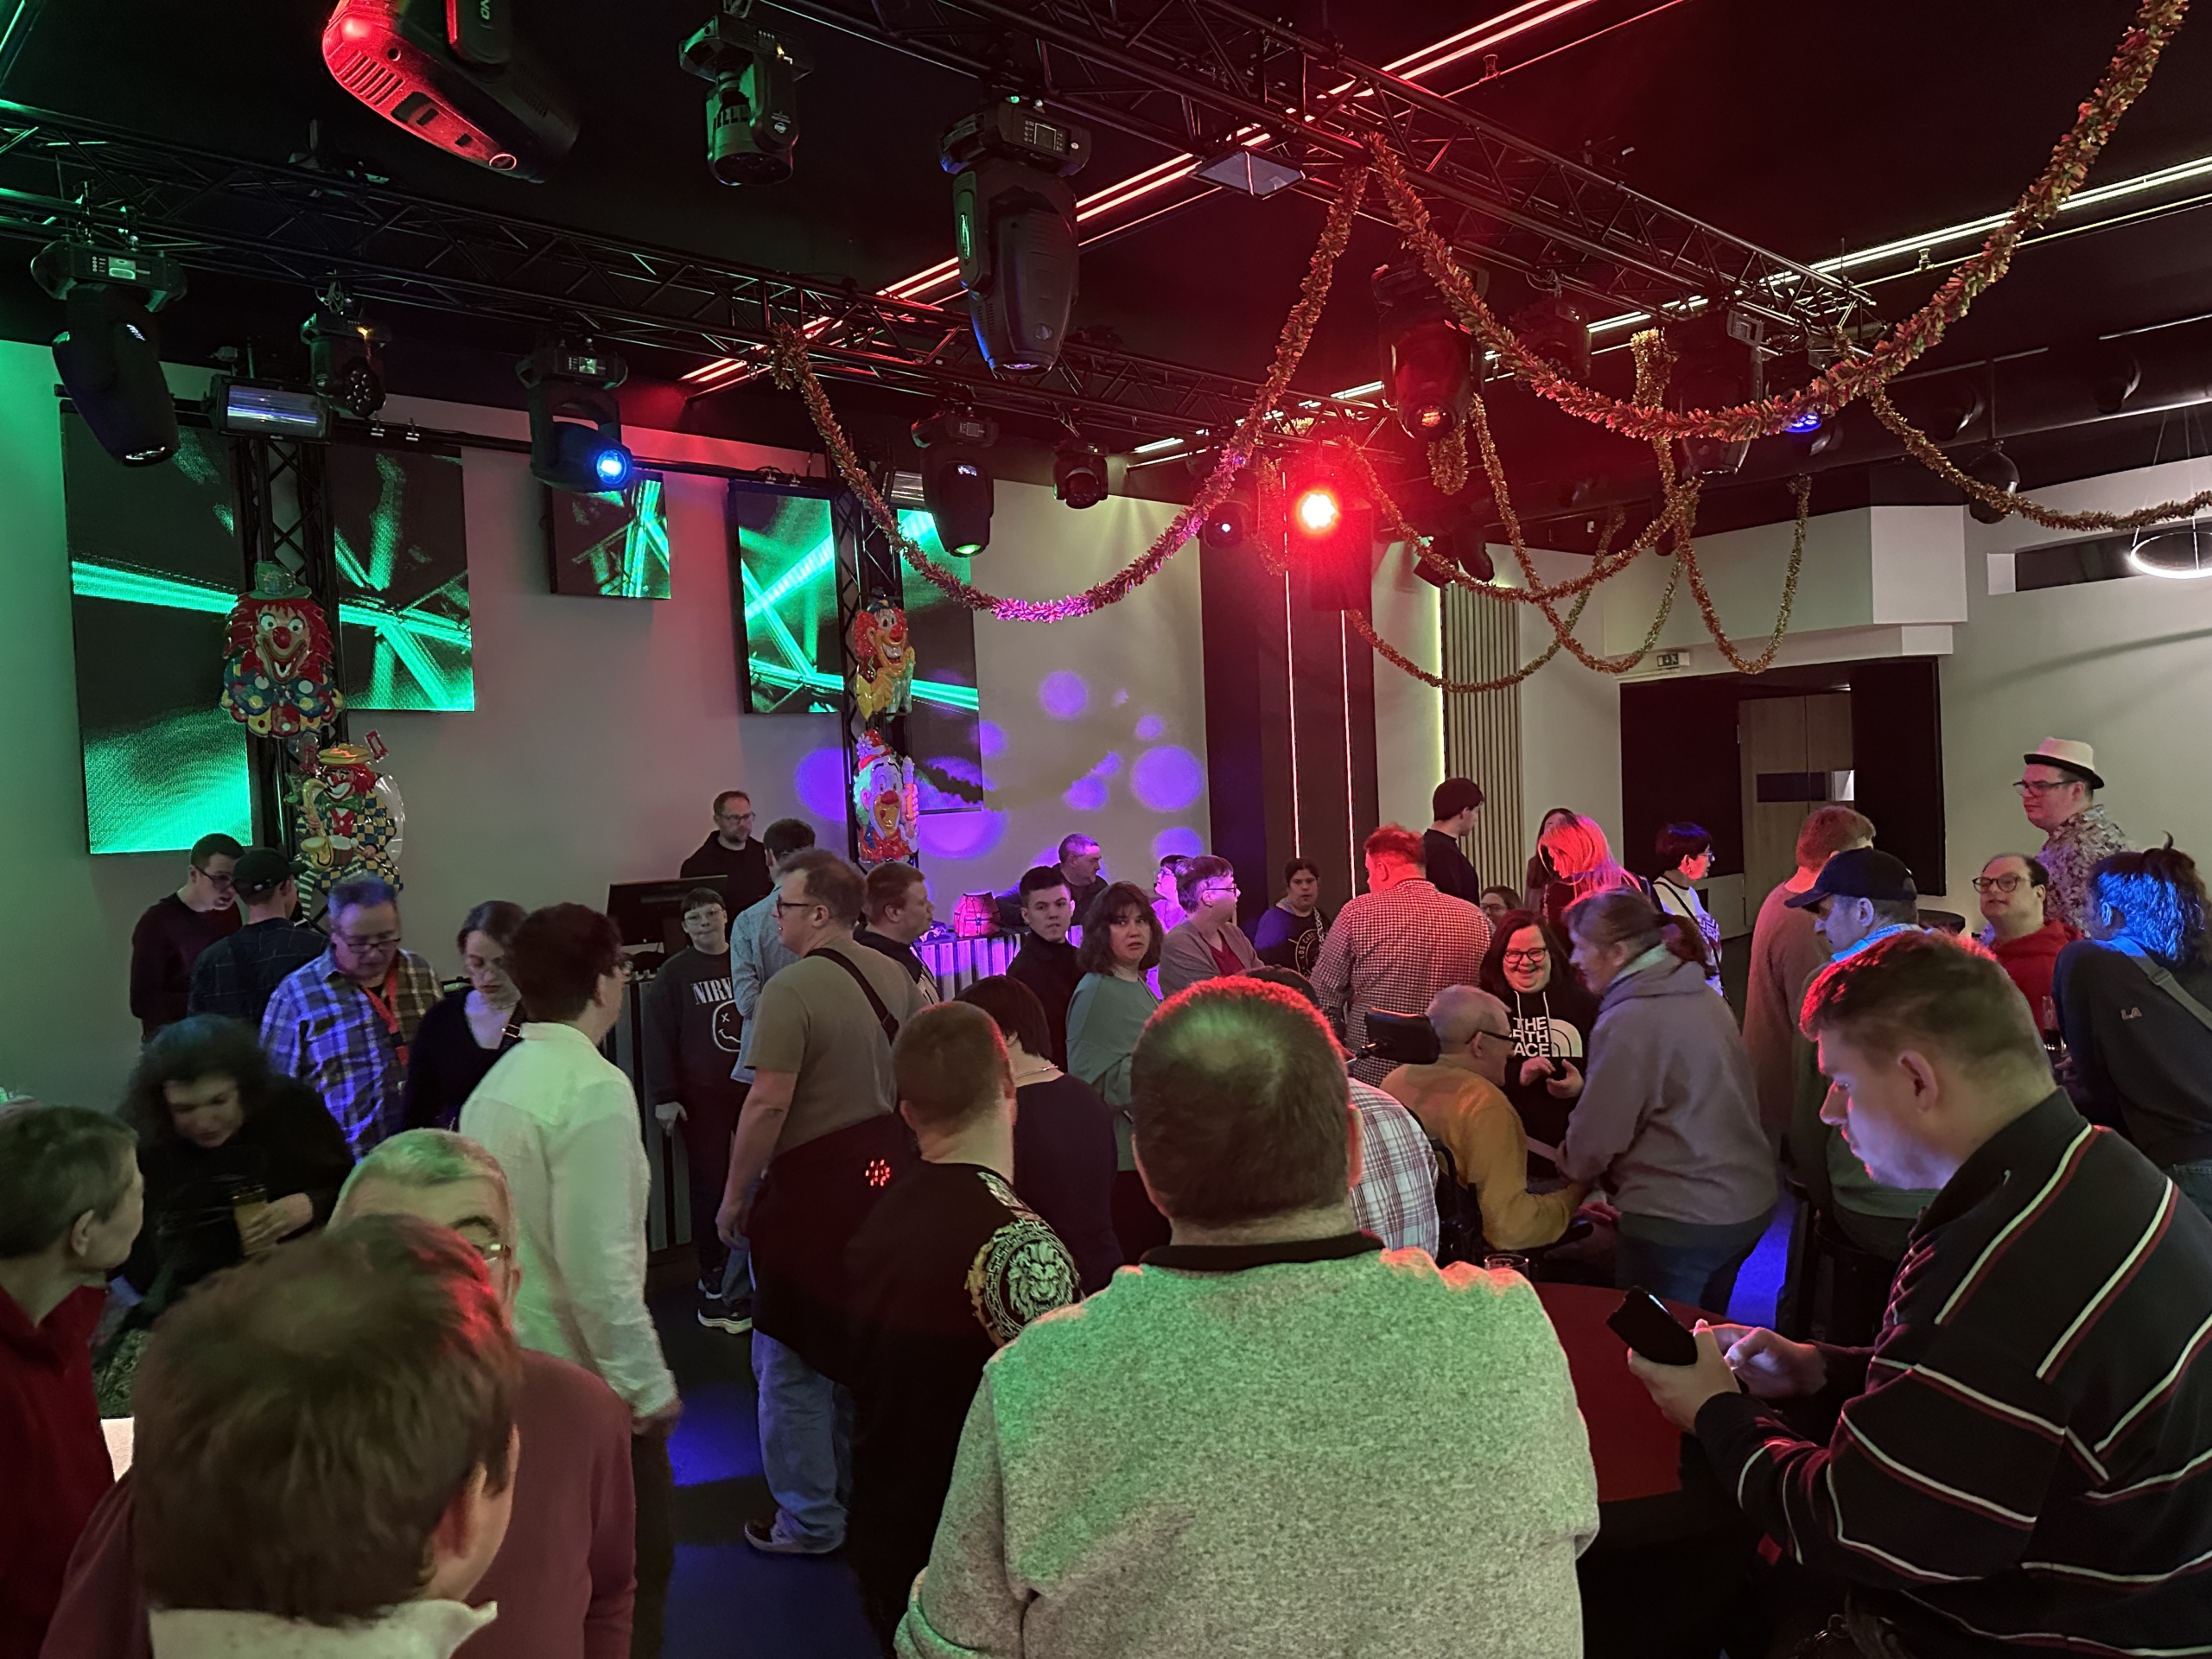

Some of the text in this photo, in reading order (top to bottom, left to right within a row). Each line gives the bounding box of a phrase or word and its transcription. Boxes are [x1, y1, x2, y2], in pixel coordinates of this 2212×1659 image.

[2120, 1007, 2143, 1020] LA
[1513, 1016, 1548, 1031] THE
[1510, 1029, 1549, 1043] RTH
